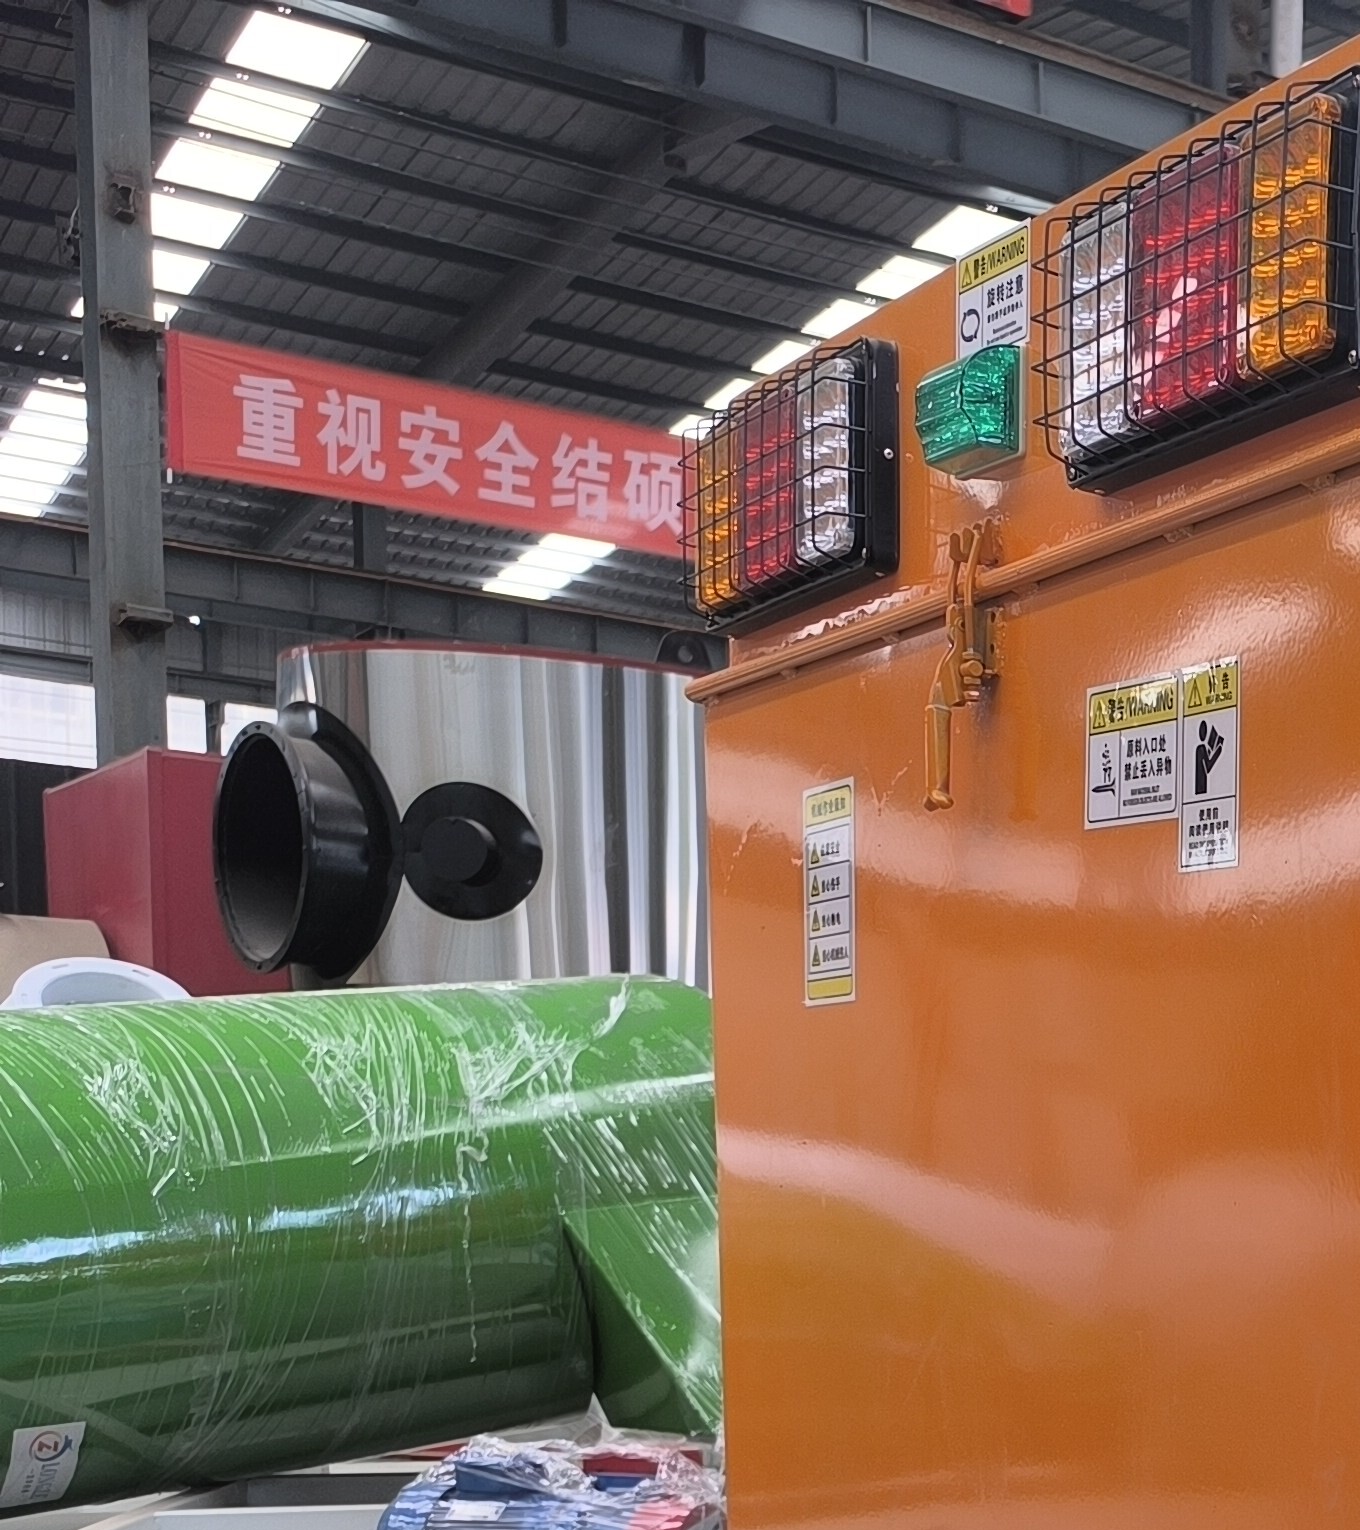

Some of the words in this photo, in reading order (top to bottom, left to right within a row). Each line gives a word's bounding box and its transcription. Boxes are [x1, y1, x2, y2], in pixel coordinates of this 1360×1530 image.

[1126, 734, 1167, 758] 原料入口处
[1124, 756, 1172, 781] 禁止丢入异物
